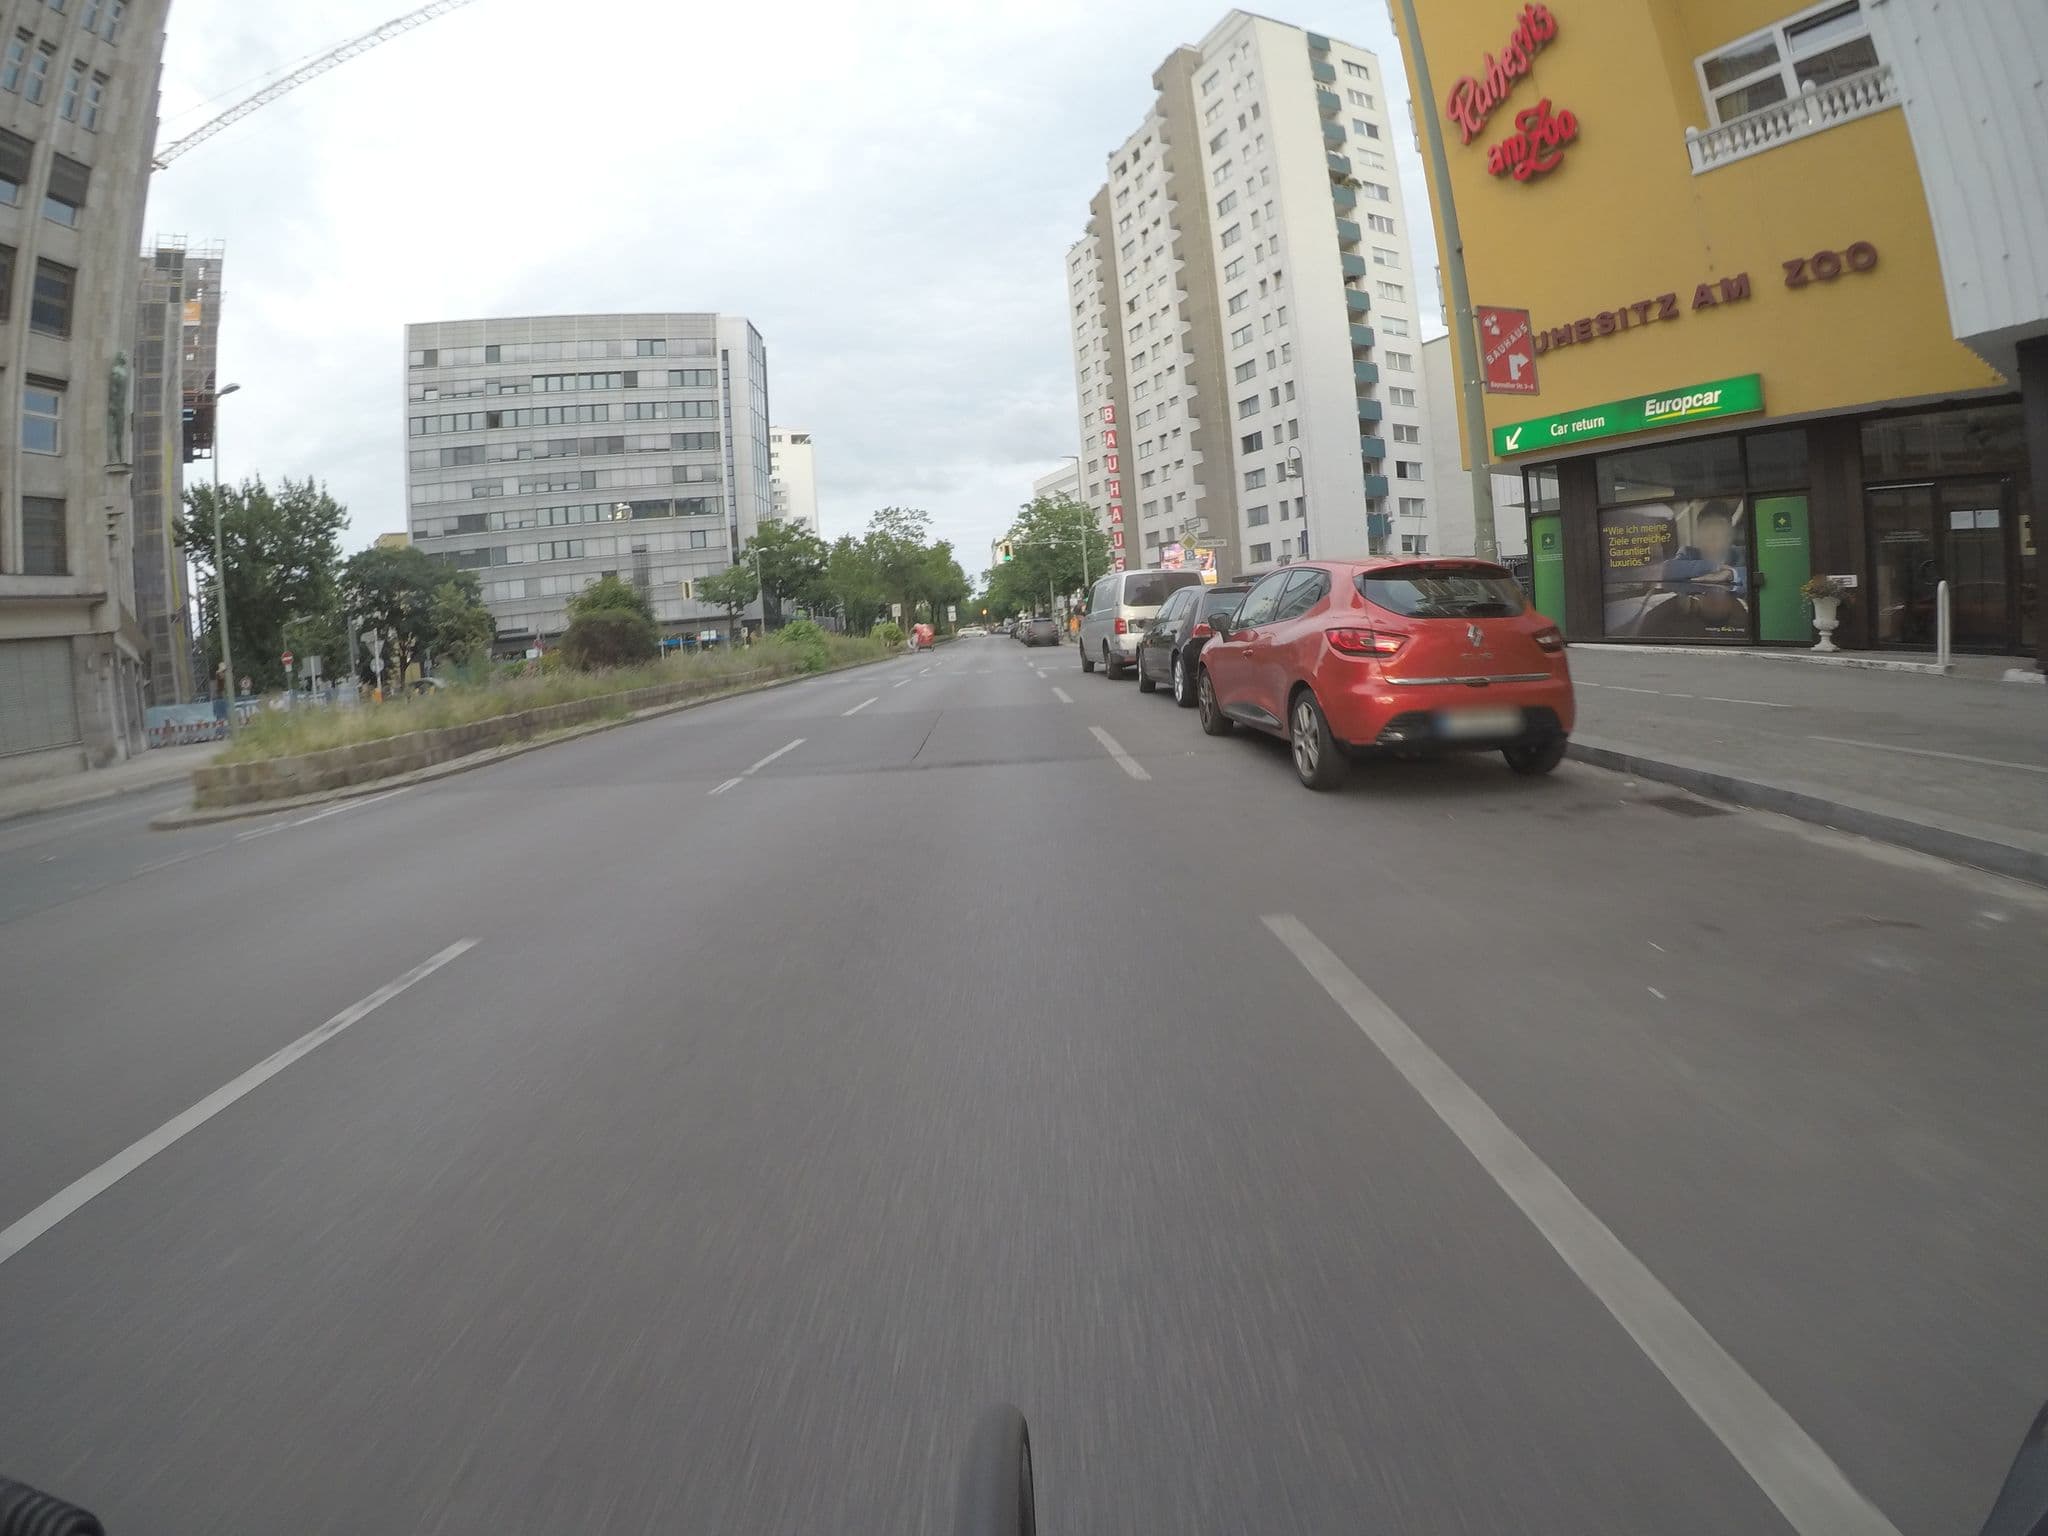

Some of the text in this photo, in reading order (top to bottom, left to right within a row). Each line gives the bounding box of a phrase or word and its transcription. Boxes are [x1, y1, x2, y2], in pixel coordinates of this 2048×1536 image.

[1488, 97, 1577, 181] am Zoo
[1532, 240, 1878, 354] UHESITZ AM ZOO
[1487, 322, 1528, 364] BAUHAUS
[1644, 389, 1722, 417] Europcar
[1550, 415, 1605, 437] Car return
[1104, 407, 1124, 573] BAUHAUS
[1609, 533, 1672, 546] Ziele erreiche?
[1626, 524, 1639, 534] ich
[1640, 523, 1668, 532] meine
[1609, 546, 1651, 556] Garantiert
